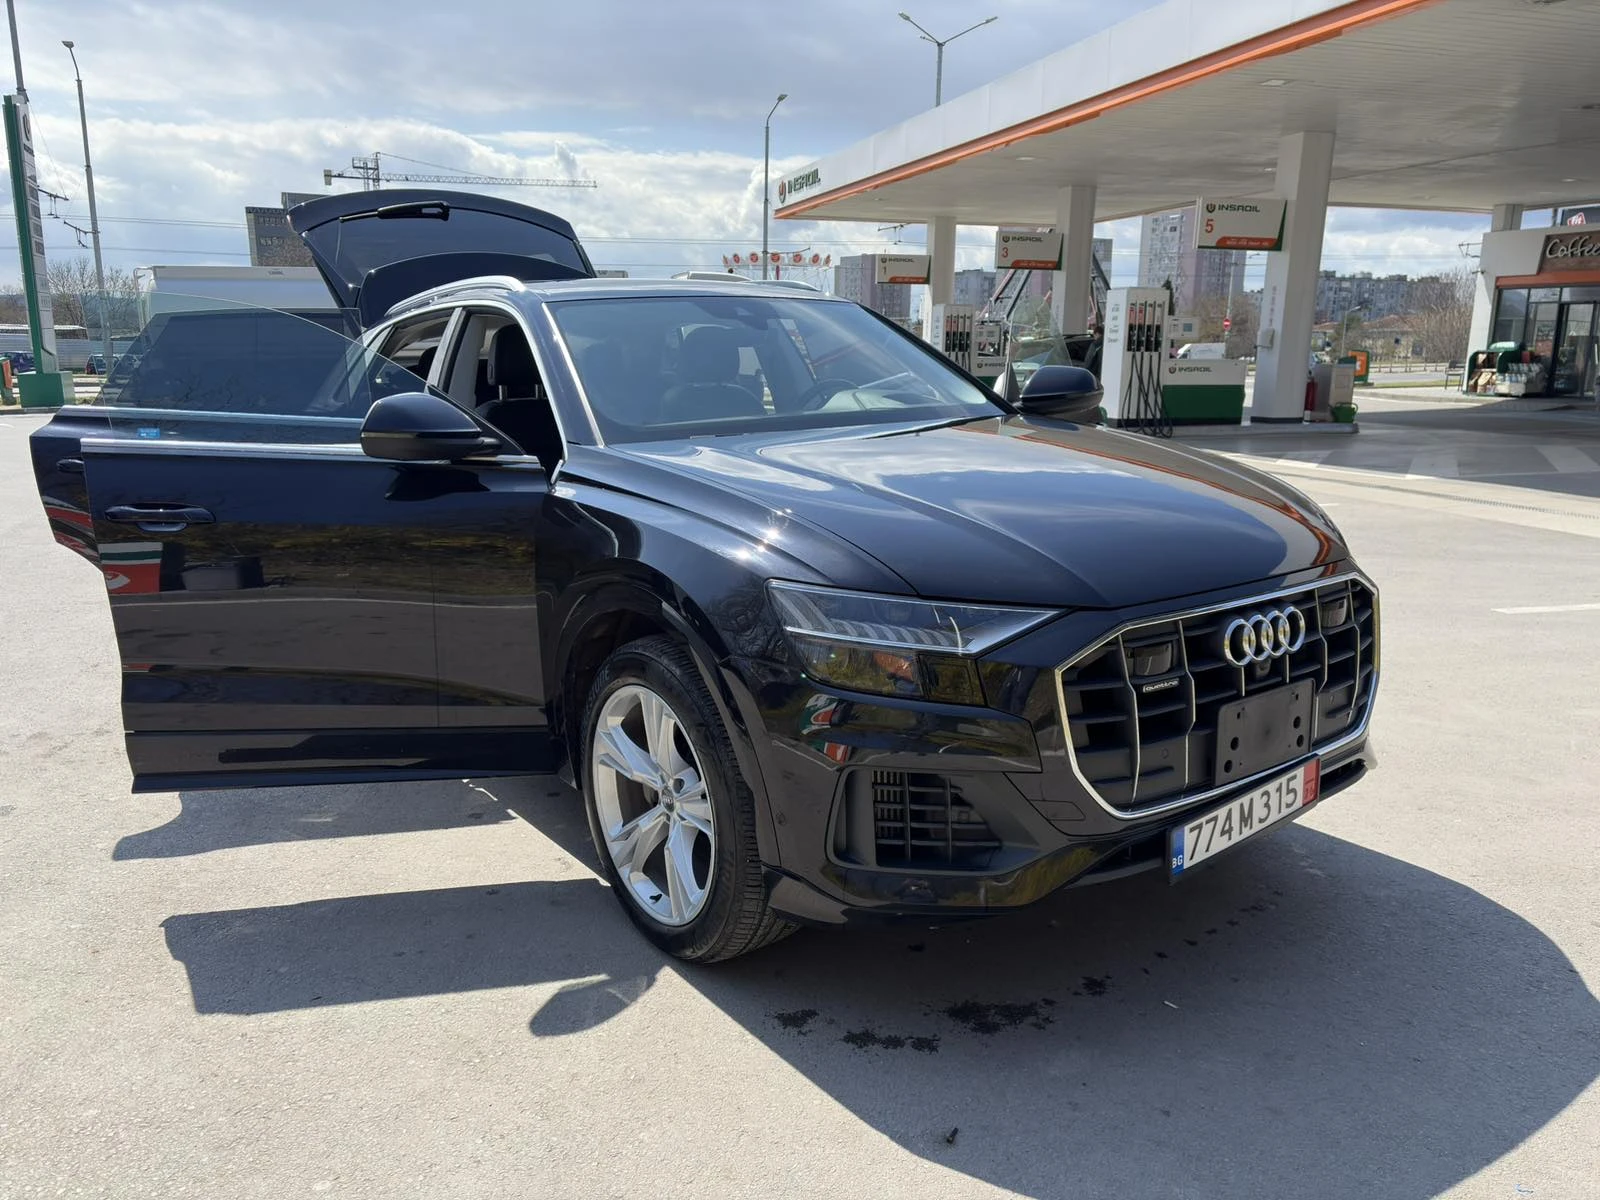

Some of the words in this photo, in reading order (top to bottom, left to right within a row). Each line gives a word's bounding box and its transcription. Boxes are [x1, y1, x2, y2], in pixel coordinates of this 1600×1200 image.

[1217, 203, 1260, 213] INSAOIL
[1205, 218, 1214, 234] 5
[1001, 246, 1009, 258] 3
[1142, 678, 1180, 693] quattro
[1171, 854, 1184, 868] BG
